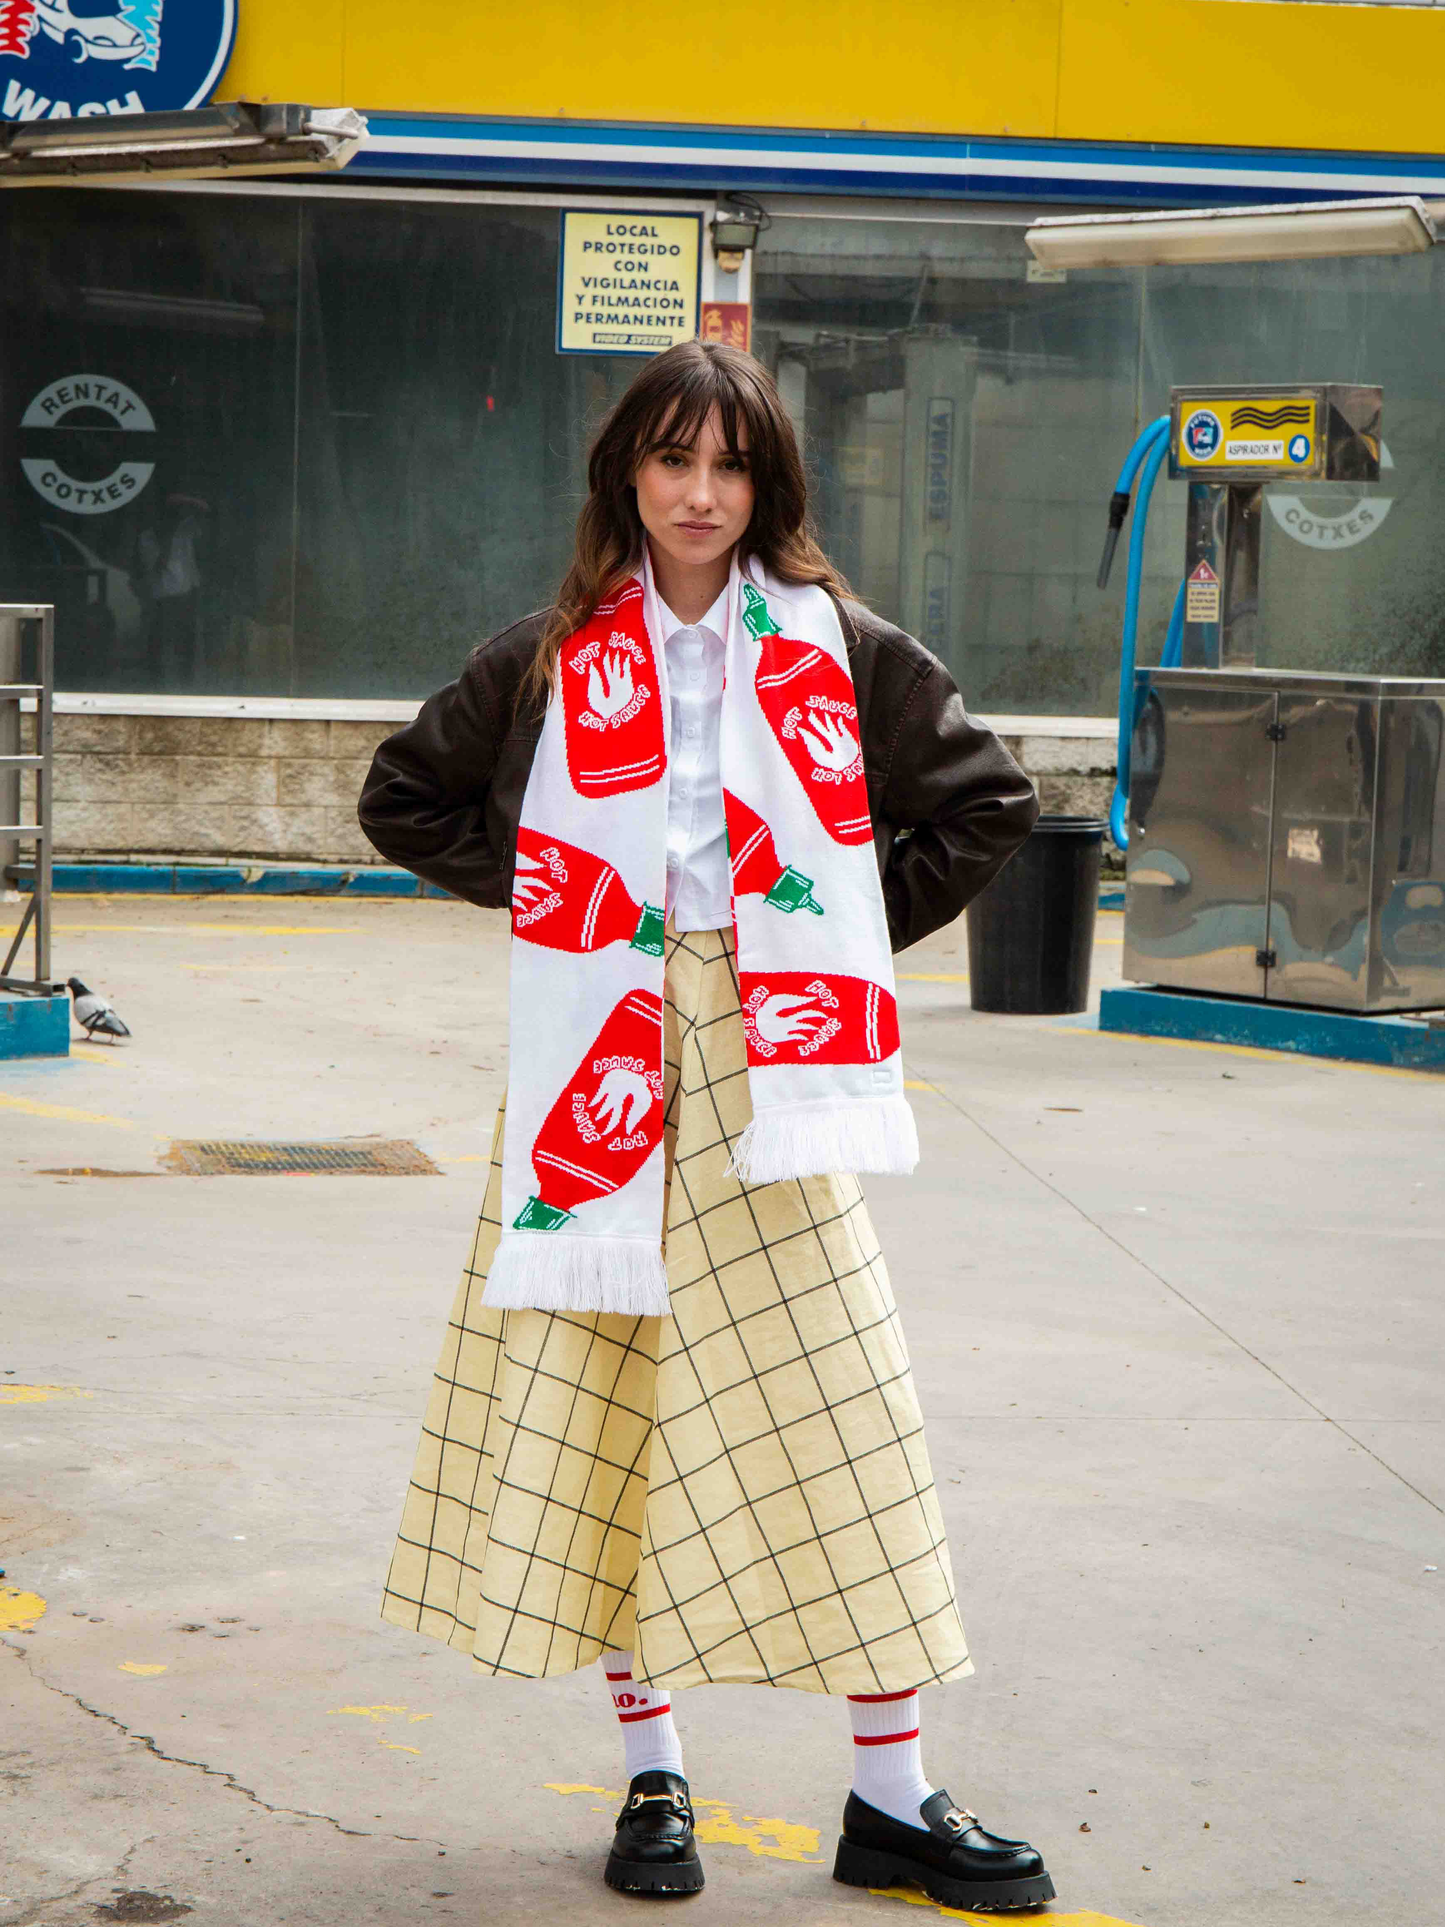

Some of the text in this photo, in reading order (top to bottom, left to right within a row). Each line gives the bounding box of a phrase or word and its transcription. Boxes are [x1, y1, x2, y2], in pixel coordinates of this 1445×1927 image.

[606, 224, 659, 238] LOCAL
[583, 241, 681, 256] PROTEGIDO
[614, 260, 649, 273] CON
[575, 293, 585, 306] Y
[581, 276, 680, 292] VIGILANCIA
[574, 312, 686, 328] PERMANENTE
[40, 383, 137, 416] RENTAT
[1228, 443, 1270, 456] ASPIRADOR
[1291, 437, 1306, 458] 4
[929, 412, 950, 522] ESPUMA
[40, 472, 137, 506] COTXES
[1284, 508, 1375, 541] COTXES
[569, 631, 647, 675] HOT SAUCE
[578, 684, 651, 732] HOT SAUCE
[781, 695, 858, 740] HOT SAUCE
[811, 767, 842, 785] HOT
[516, 847, 568, 928] HOT SAUCE
[742, 985, 778, 1058] HOT SAUCE
[797, 980, 843, 1057] HOT SAUCE
[593, 1055, 646, 1074] SAUCE
[572, 1093, 649, 1151] HOT SAUCE
